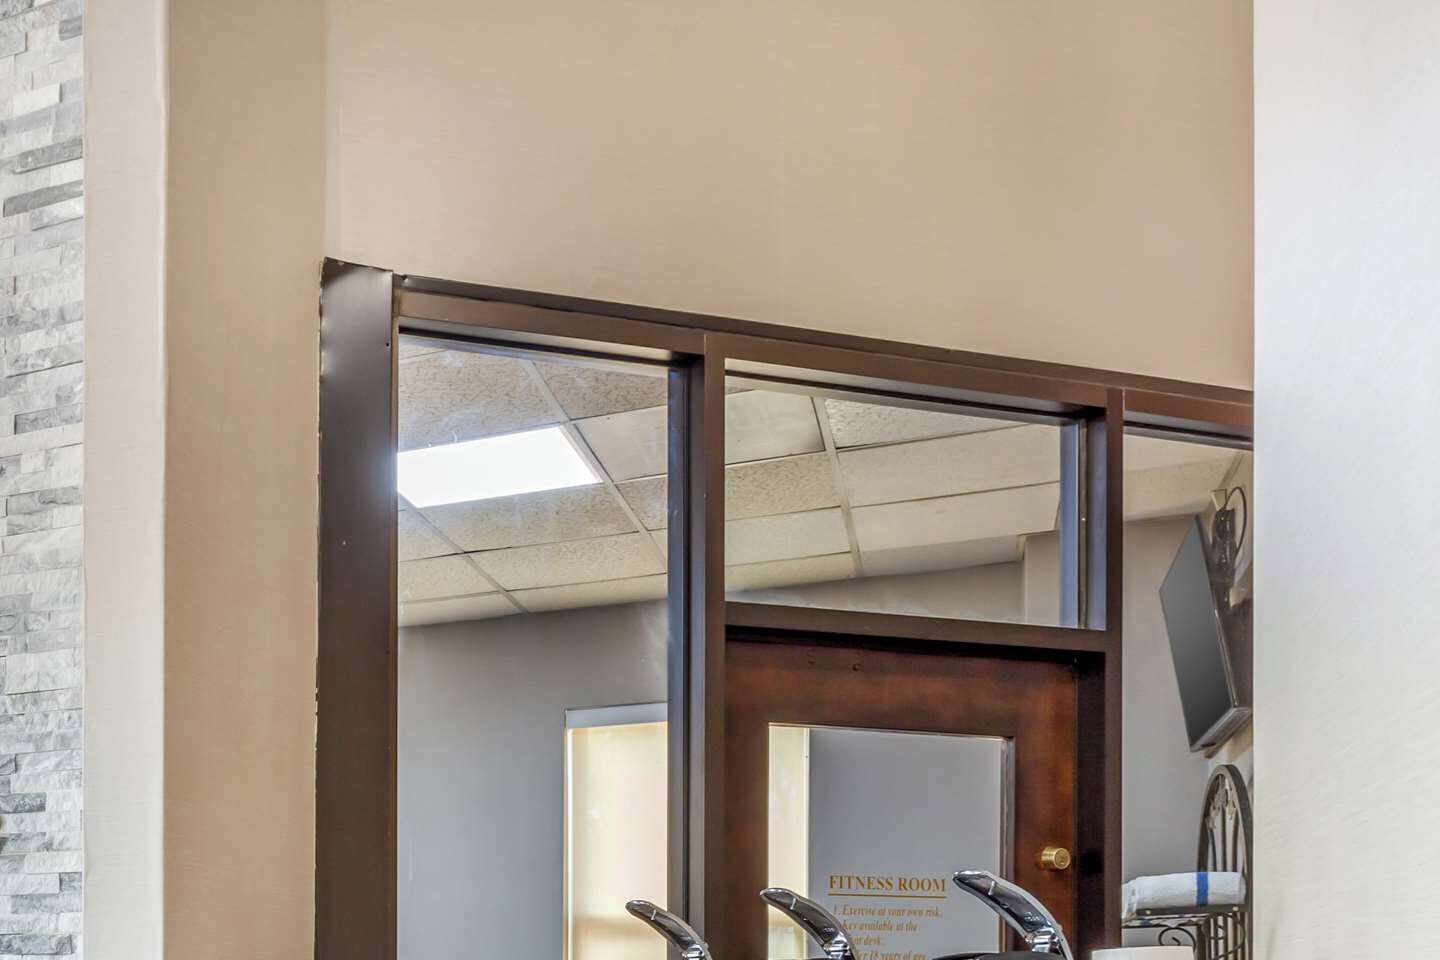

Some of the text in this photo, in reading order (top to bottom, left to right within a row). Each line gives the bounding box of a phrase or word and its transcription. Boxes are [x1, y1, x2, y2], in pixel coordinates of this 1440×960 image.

[829, 875, 946, 892] FITNESS ROOM
[842, 904, 876, 917] Exercise
[878, 906, 888, 917] at
[888, 907, 906, 919] your
[907, 908, 927, 918] own
[859, 920, 893, 932] available
[895, 922, 905, 932] at
[905, 921, 918, 933] the
